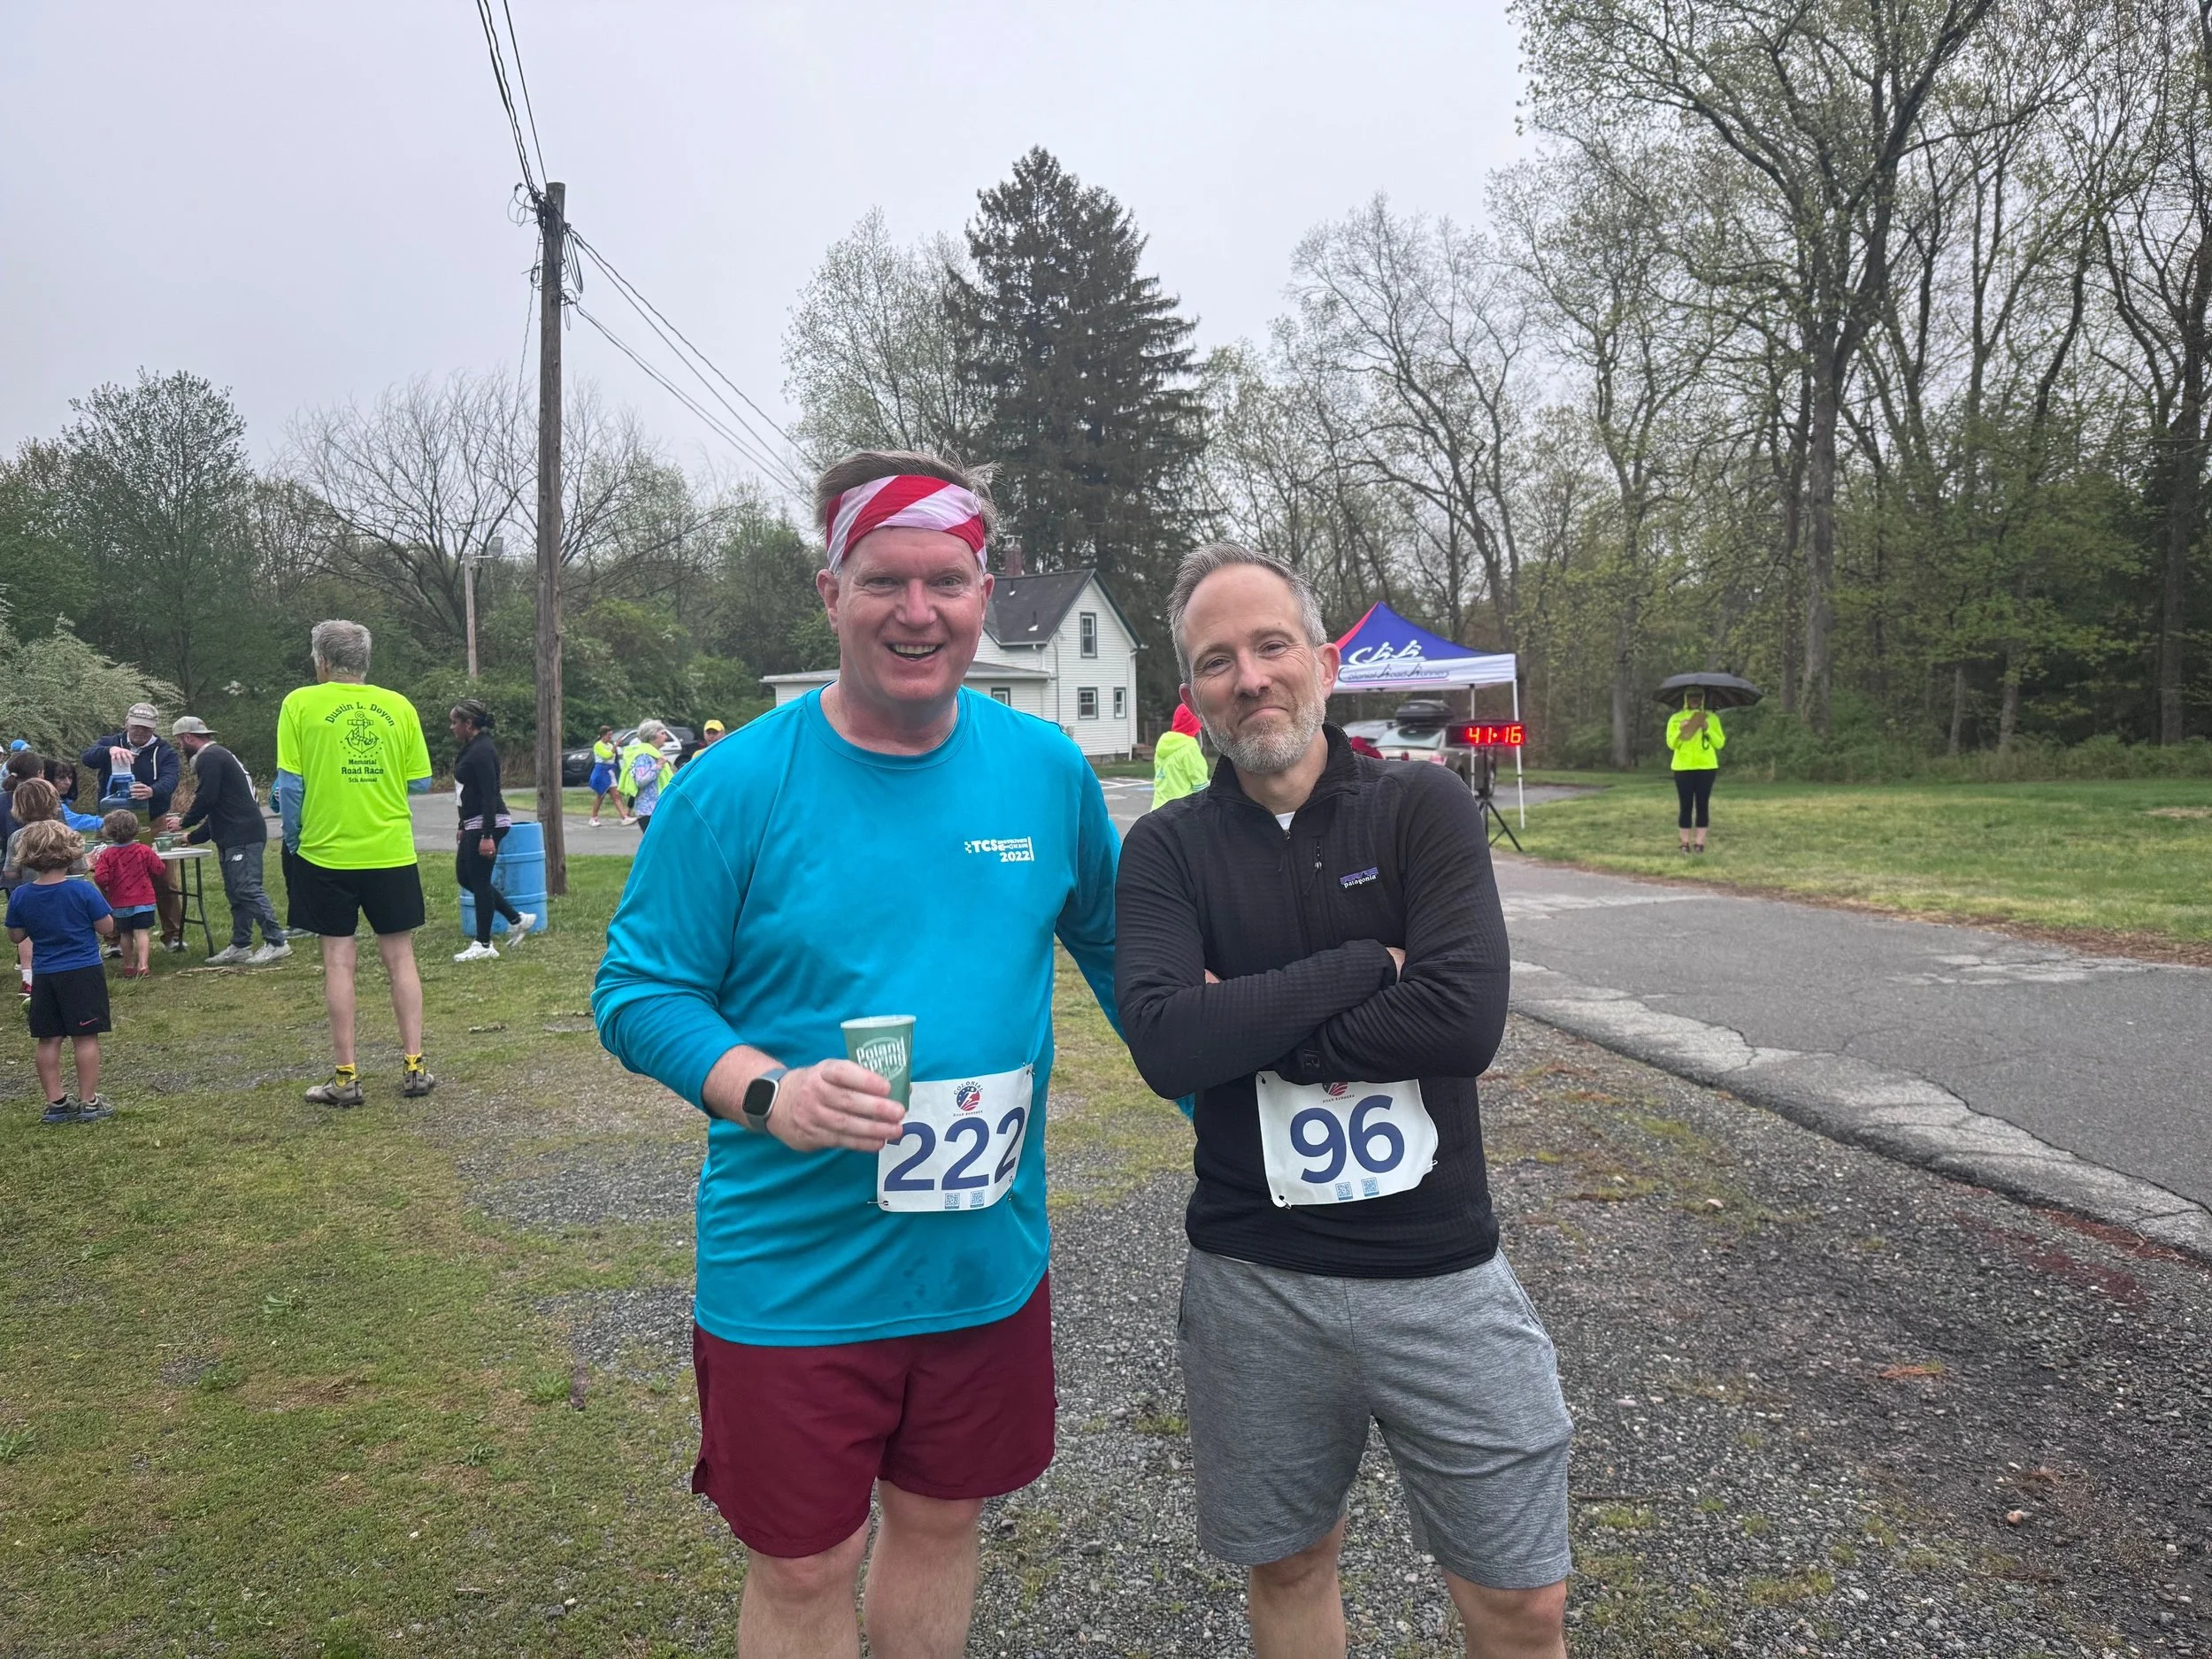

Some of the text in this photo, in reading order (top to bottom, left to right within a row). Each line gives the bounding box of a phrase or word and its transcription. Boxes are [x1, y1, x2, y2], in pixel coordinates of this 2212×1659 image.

[325, 703, 354, 725] Dustin
[370, 703, 396, 727] Doyon
[342, 766, 384, 775] Road Race
[971, 839, 997, 853] TCS
[999, 850, 1031, 863] 2022
[1344, 874, 1377, 888] patagonia
[856, 1036, 905, 1064] Poland
[954, 1080, 984, 1095] COLONIAL
[1290, 1094, 1405, 1184] 96
[884, 1107, 1025, 1192] 222
